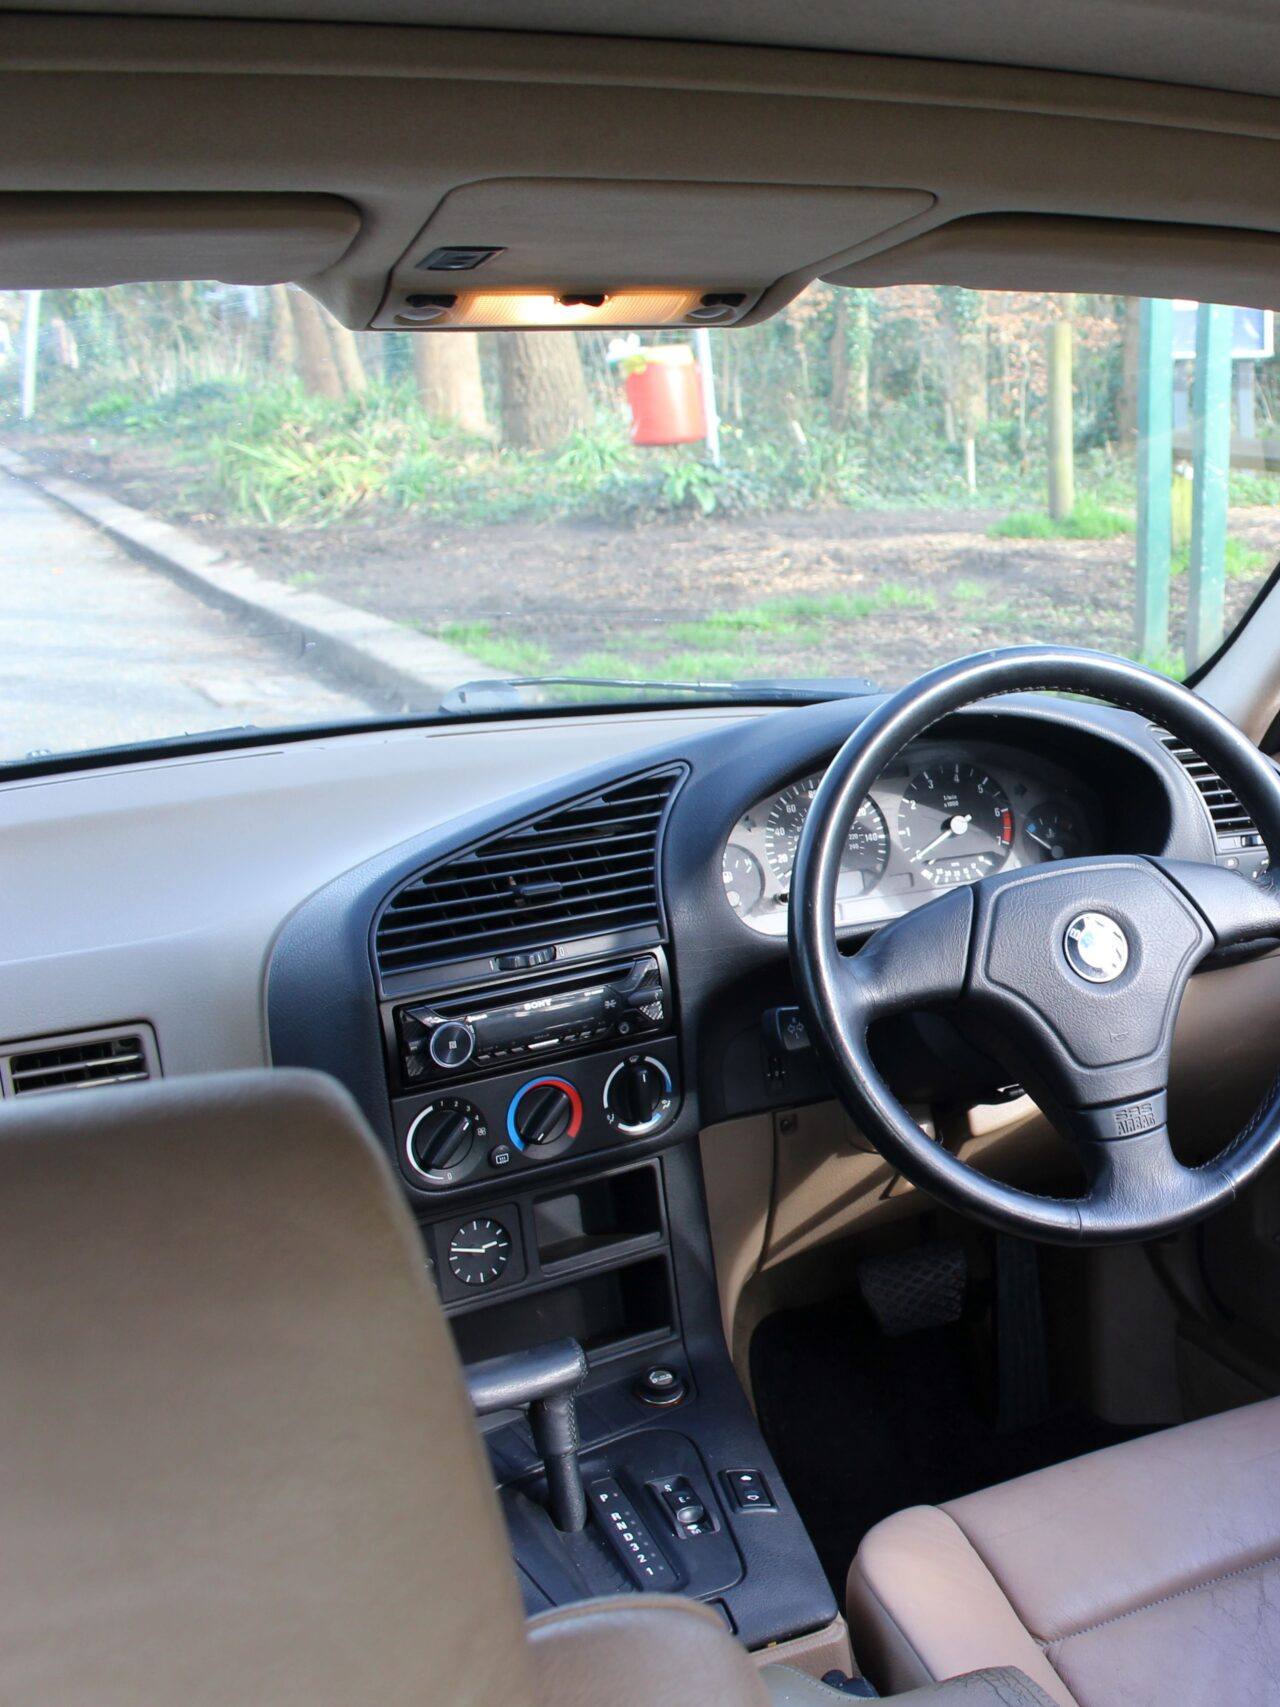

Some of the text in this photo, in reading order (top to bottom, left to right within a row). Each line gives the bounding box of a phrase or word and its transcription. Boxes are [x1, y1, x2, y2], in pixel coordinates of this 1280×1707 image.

[953, 773, 960, 783] 4
[928, 779, 934, 789] 3
[977, 784, 984, 794] 5
[785, 803, 797, 813] 60
[910, 800, 917, 810] 2
[994, 807, 1001, 817] 6
[774, 827, 786, 836] 40
[864, 832, 878, 842] 140
[777, 853, 788, 863] 20
[523, 999, 552, 1011] SONY
[1118, 1113, 1156, 1135] AIRBAG
[599, 1493, 609, 1502] P
[610, 1512, 622, 1521] R
[616, 1521, 628, 1530] N
[623, 1532, 634, 1541] D
[629, 1543, 640, 1551] 3
[637, 1554, 647, 1563] 2
[646, 1567, 654, 1576] 1
